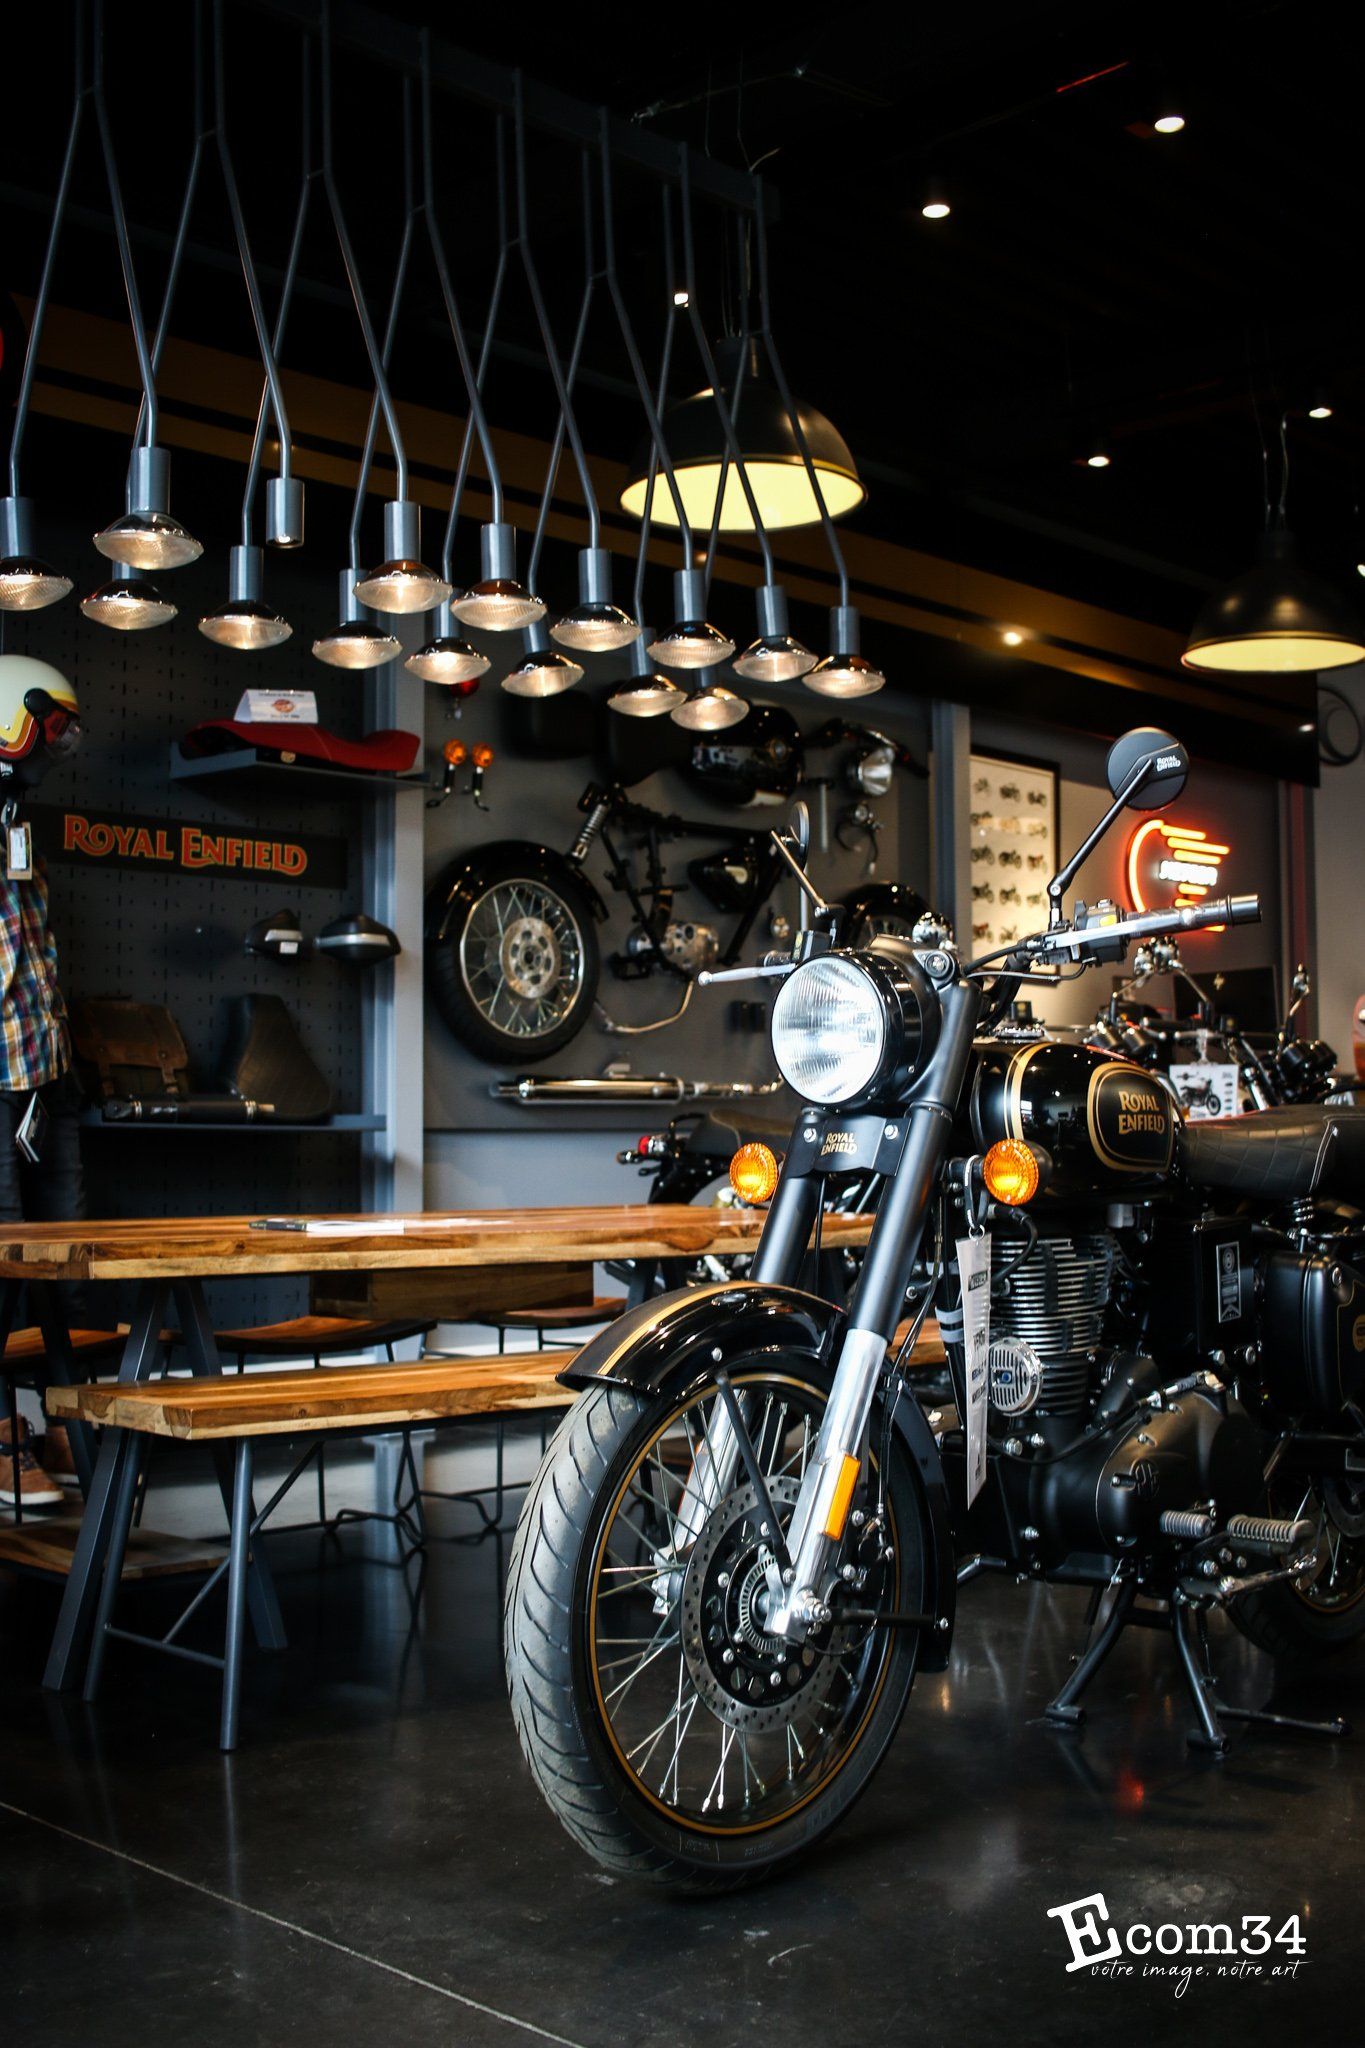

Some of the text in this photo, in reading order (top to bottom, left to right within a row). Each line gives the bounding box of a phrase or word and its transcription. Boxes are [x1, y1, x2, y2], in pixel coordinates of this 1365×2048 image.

[64, 814, 307, 876] ROYAL ENFIELD
[1118, 1091, 1160, 1112] ROYAL
[1118, 1114, 1165, 1135] ENFIELD
[826, 1132, 855, 1143] ROYAL
[820, 1143, 858, 1156] ENFIELD
